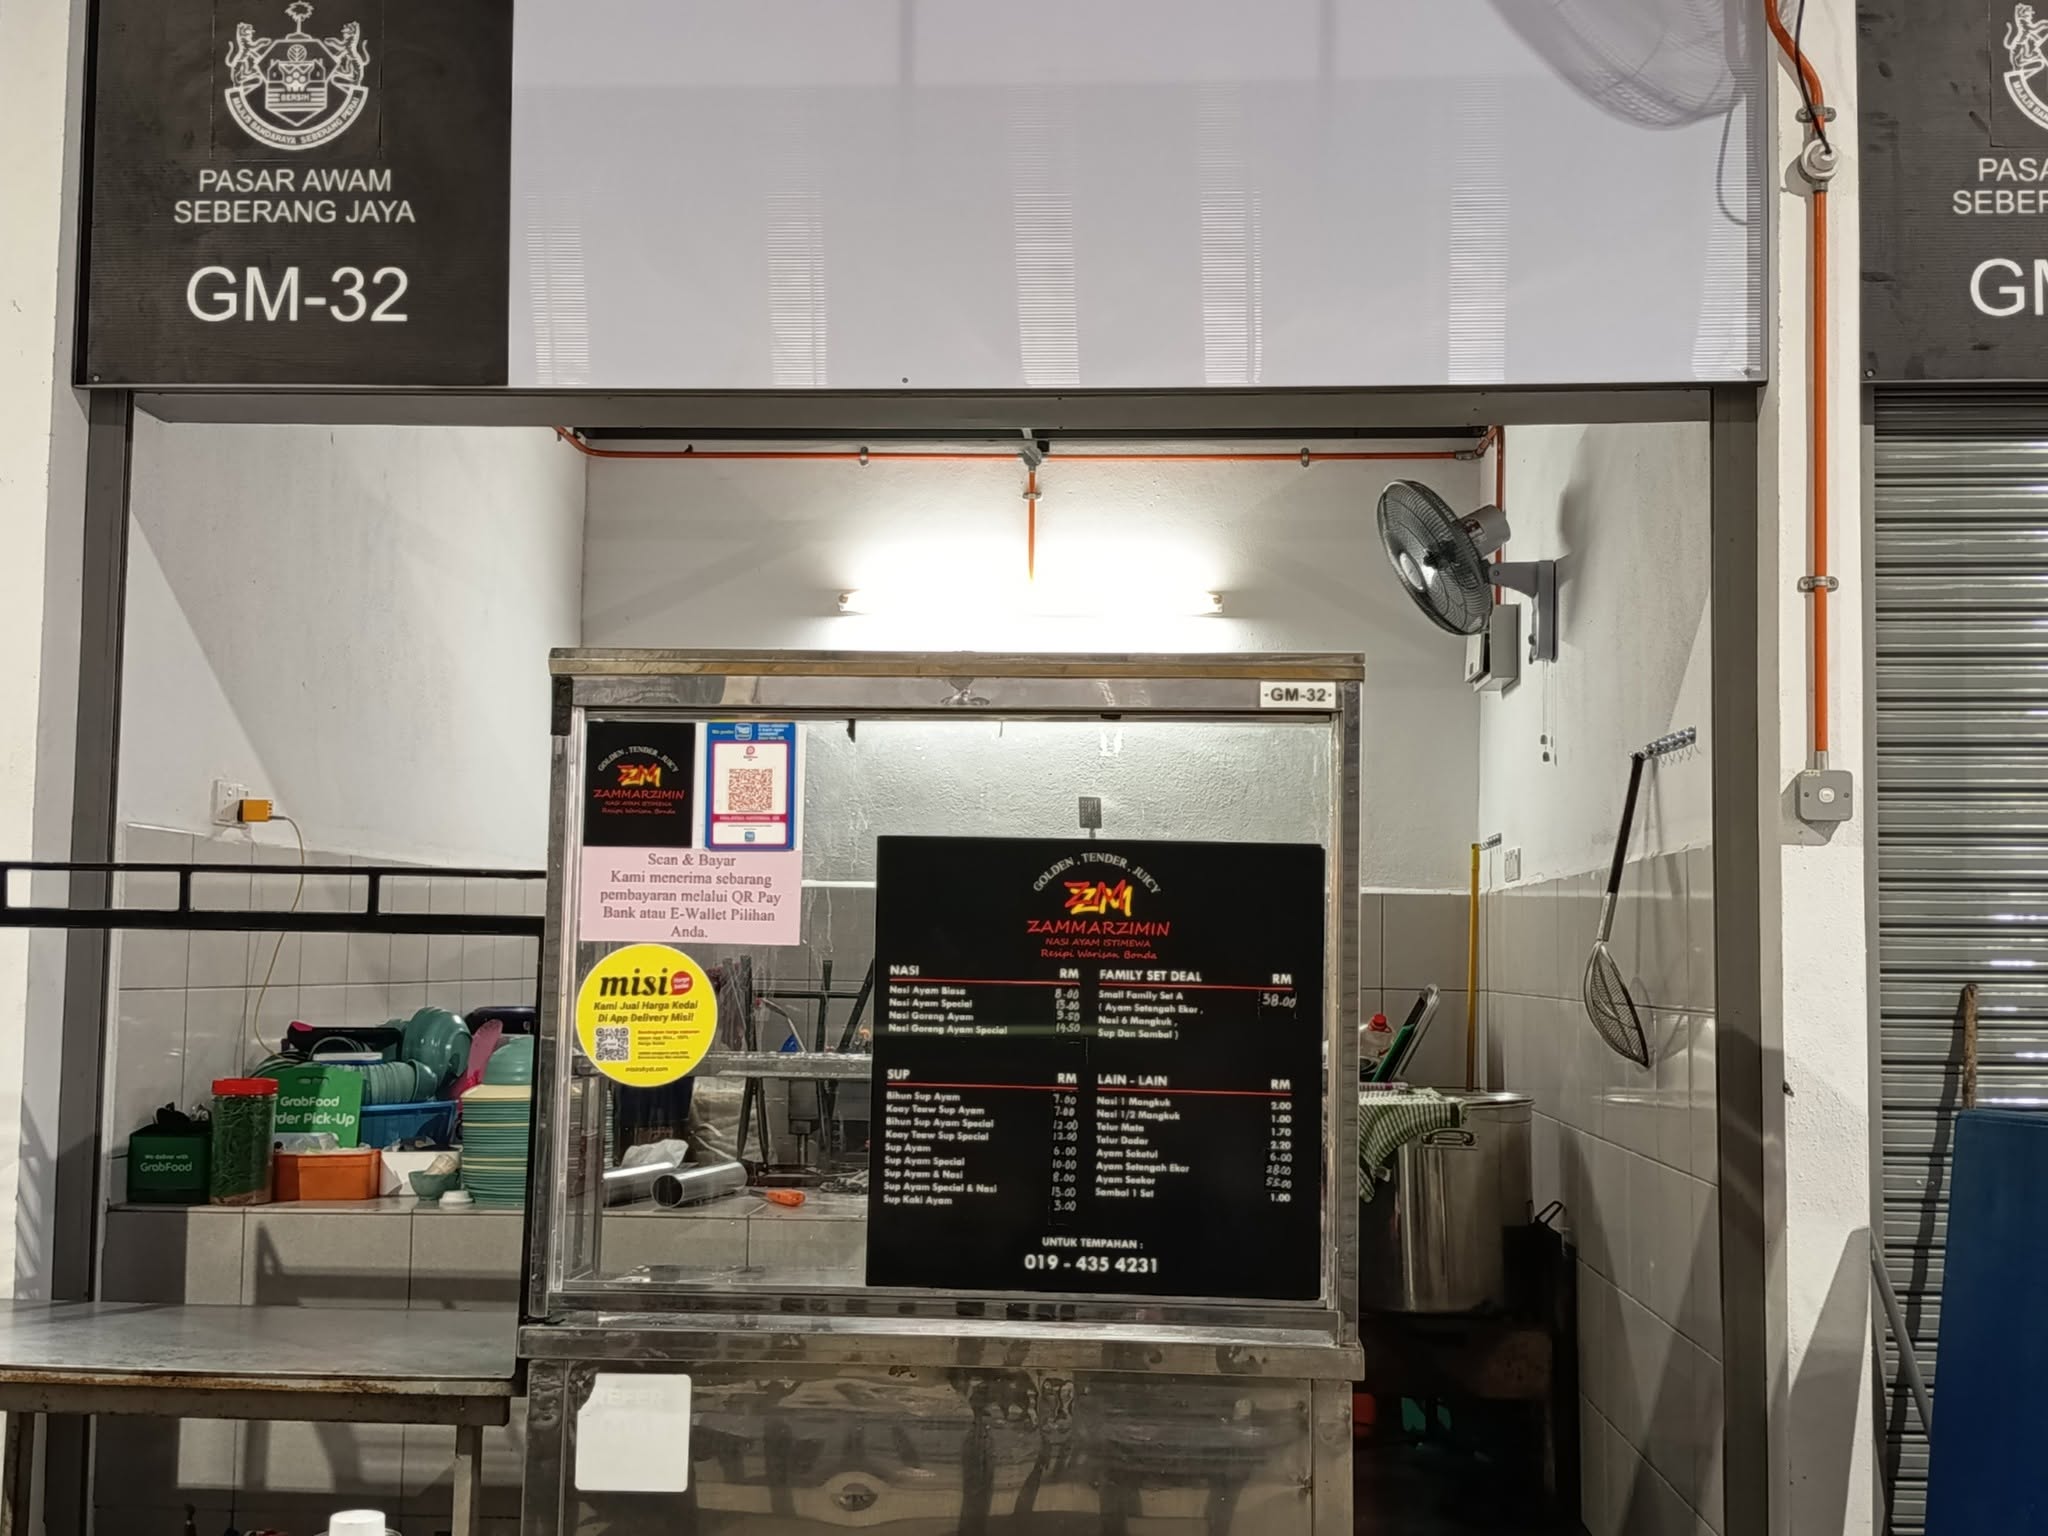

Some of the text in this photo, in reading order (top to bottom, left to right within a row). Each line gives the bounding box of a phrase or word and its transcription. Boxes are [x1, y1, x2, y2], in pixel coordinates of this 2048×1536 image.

[300, 97, 359, 144] SEBERANG PERAI
[199, 169, 392, 193] PASAR AWAM
[174, 200, 416, 224] SEBERANG JAYA
[1970, 258, 2048, 316] G
[187, 266, 408, 322] GM-32
[629, 746, 658, 756] TENDER
[593, 789, 685, 799] ZAMMARZIMIN
[648, 853, 736, 869] Scan & Bayar
[1033, 853, 1161, 894] GOLDEN TENDER JUICY
[611, 871, 772, 888] Kami menerima sebarang
[600, 889, 781, 906] pembayaran melalui QR Pay
[603, 906, 775, 921] Bank atau E-Wallet Pilihan
[671, 925, 708, 938] Anda.
[1027, 920, 1171, 937] ZAMMARZIMIN
[1045, 938, 1151, 947] NASI AYAM ISTIMEWA
[1041, 949, 1158, 960] Resipi Warisan Bonda
[889, 965, 920, 976] NASI
[1060, 968, 1080, 979] RM
[1099, 970, 1202, 983] FAMILY SET DEAL
[1272, 974, 1292, 985] RM
[600, 968, 668, 997] misi
[889, 986, 909, 994] Nasi
[912, 987, 939, 996] Ayam
[1099, 991, 1124, 999] Small
[1127, 991, 1157, 1001] Family
[1160, 992, 1174, 1000] Set
[594, 1000, 698, 1012] Kami Jual Harga Kedai
[889, 999, 972, 1010] Nasi Ayam Special
[1105, 1004, 1198, 1015] Ayam Setengah Ekor
[598, 1013, 694, 1024] Di App Delivery Misi!
[889, 1012, 974, 1022] Nasi Goreng Ayam
[1098, 1016, 1172, 1027] Nasi Mangkuk
[889, 1025, 1008, 1036] Nasi Goreng Ayam Special
[1098, 1029, 1172, 1039] Sup Dan Sambal
[887, 1069, 910, 1080] SUP
[1057, 1073, 1077, 1084] RM
[1098, 1074, 1168, 1086] LAIN LAIN
[1271, 1079, 1291, 1090] RM
[280, 1096, 340, 1107] GrabFood
[887, 1091, 961, 1102] Bihun Sup Ayam
[1097, 1097, 1171, 1108] Nasi Mangkuk
[1271, 1102, 1292, 1111] 2.00
[939, 1105, 985, 1115] Sup Ayam
[1097, 1110, 1180, 1121] Nasi 1/2 Mangkuk
[275, 1112, 355, 1127] rder Pick-Up
[886, 1118, 994, 1129] Bihun Sup Ayam Special
[1271, 1115, 1292, 1124] 1.00
[1097, 1123, 1144, 1132] Telur Mata
[1271, 1128, 1291, 1136] 1.70
[939, 1131, 989, 1142] Sup Special
[1097, 1136, 1149, 1145] Telur Dadar
[885, 1143, 931, 1153] Sup Ayam
[1270, 1141, 1291, 1150] 2.20
[1096, 1149, 1123, 1159] Ayam
[885, 1156, 965, 1166] Sup Ayam Special
[140, 1162, 193, 1172] GrabFood
[1096, 1162, 1190, 1173] Ayam Setengah Ekor
[884, 1169, 963, 1179] Sup Ayam Nasi
[1096, 1175, 1123, 1185] Ayam
[884, 1182, 997, 1193] Sup Ayam Special Nasi
[1095, 1188, 1154, 1198] Sambal Set
[883, 1195, 952, 1205] Sup Kaki Ayam
[1270, 1194, 1291, 1202] 1.00
[1042, 1237, 1138, 1249] UNTUK TEMPAHAN
[1024, 1254, 1058, 1270] 019
[1076, 1256, 1110, 1272] 435
[1115, 1257, 1157, 1273] 4231
